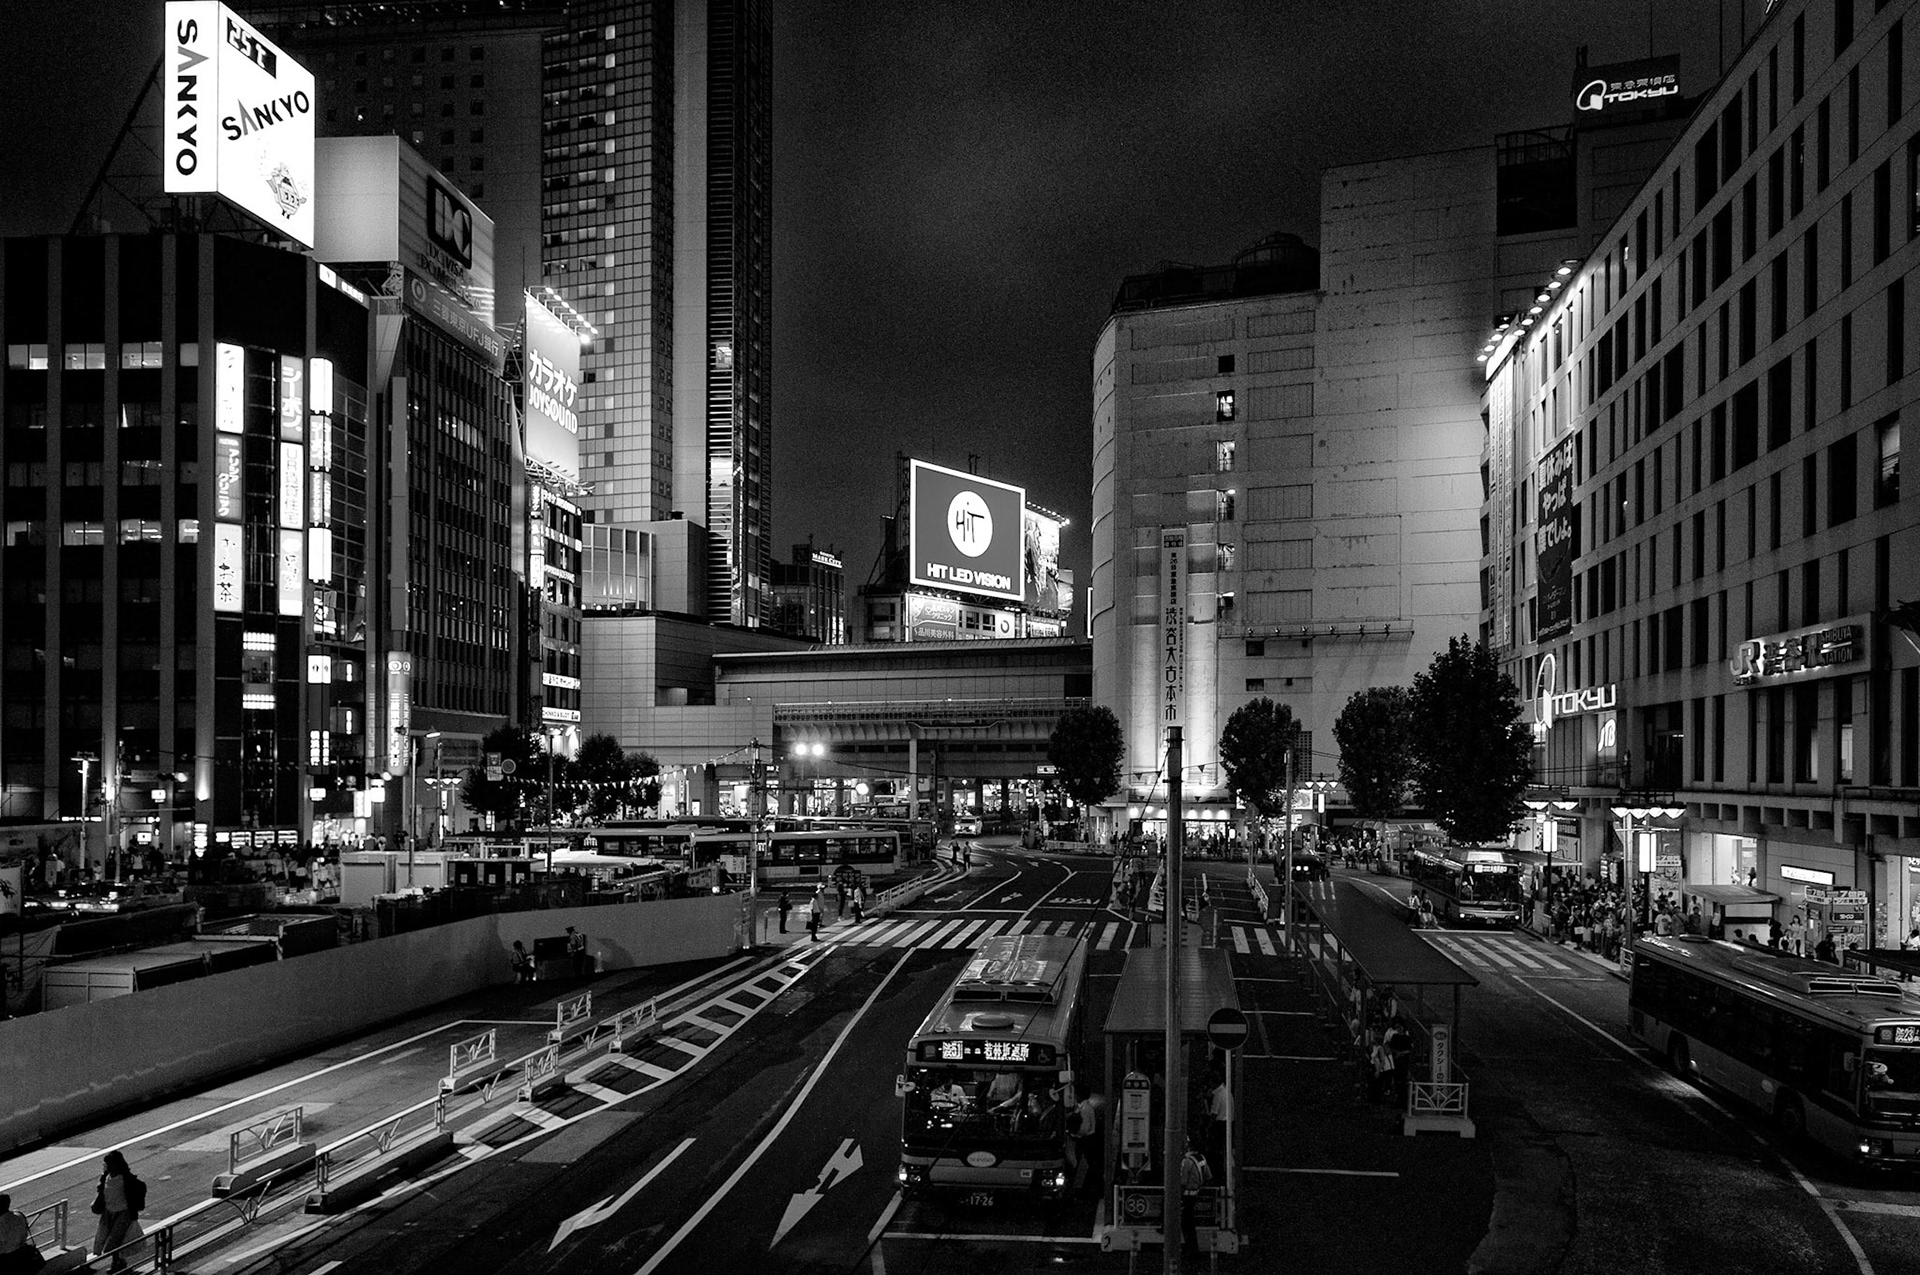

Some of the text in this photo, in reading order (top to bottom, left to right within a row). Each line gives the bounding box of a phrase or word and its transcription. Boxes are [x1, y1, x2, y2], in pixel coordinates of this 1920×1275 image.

[176, 19, 209, 176] SANKYO
[1604, 85, 1678, 103] TOKYU
[222, 91, 309, 140] SANKYO
[529, 348, 578, 408] カラオケ
[528, 383, 578, 435] JOYSOUND
[1539, 439, 1573, 492] 夏休みは
[927, 562, 1011, 591] HIT LED VISION
[1821, 625, 1852, 642] SHIBUYA
[1165, 606, 1178, 721] 渋谷大古本市
[1730, 641, 1755, 676] JR
[1821, 646, 1853, 665] STATION
[1551, 683, 1617, 715] TOKYU
[1127, 1199, 1146, 1213] 36
